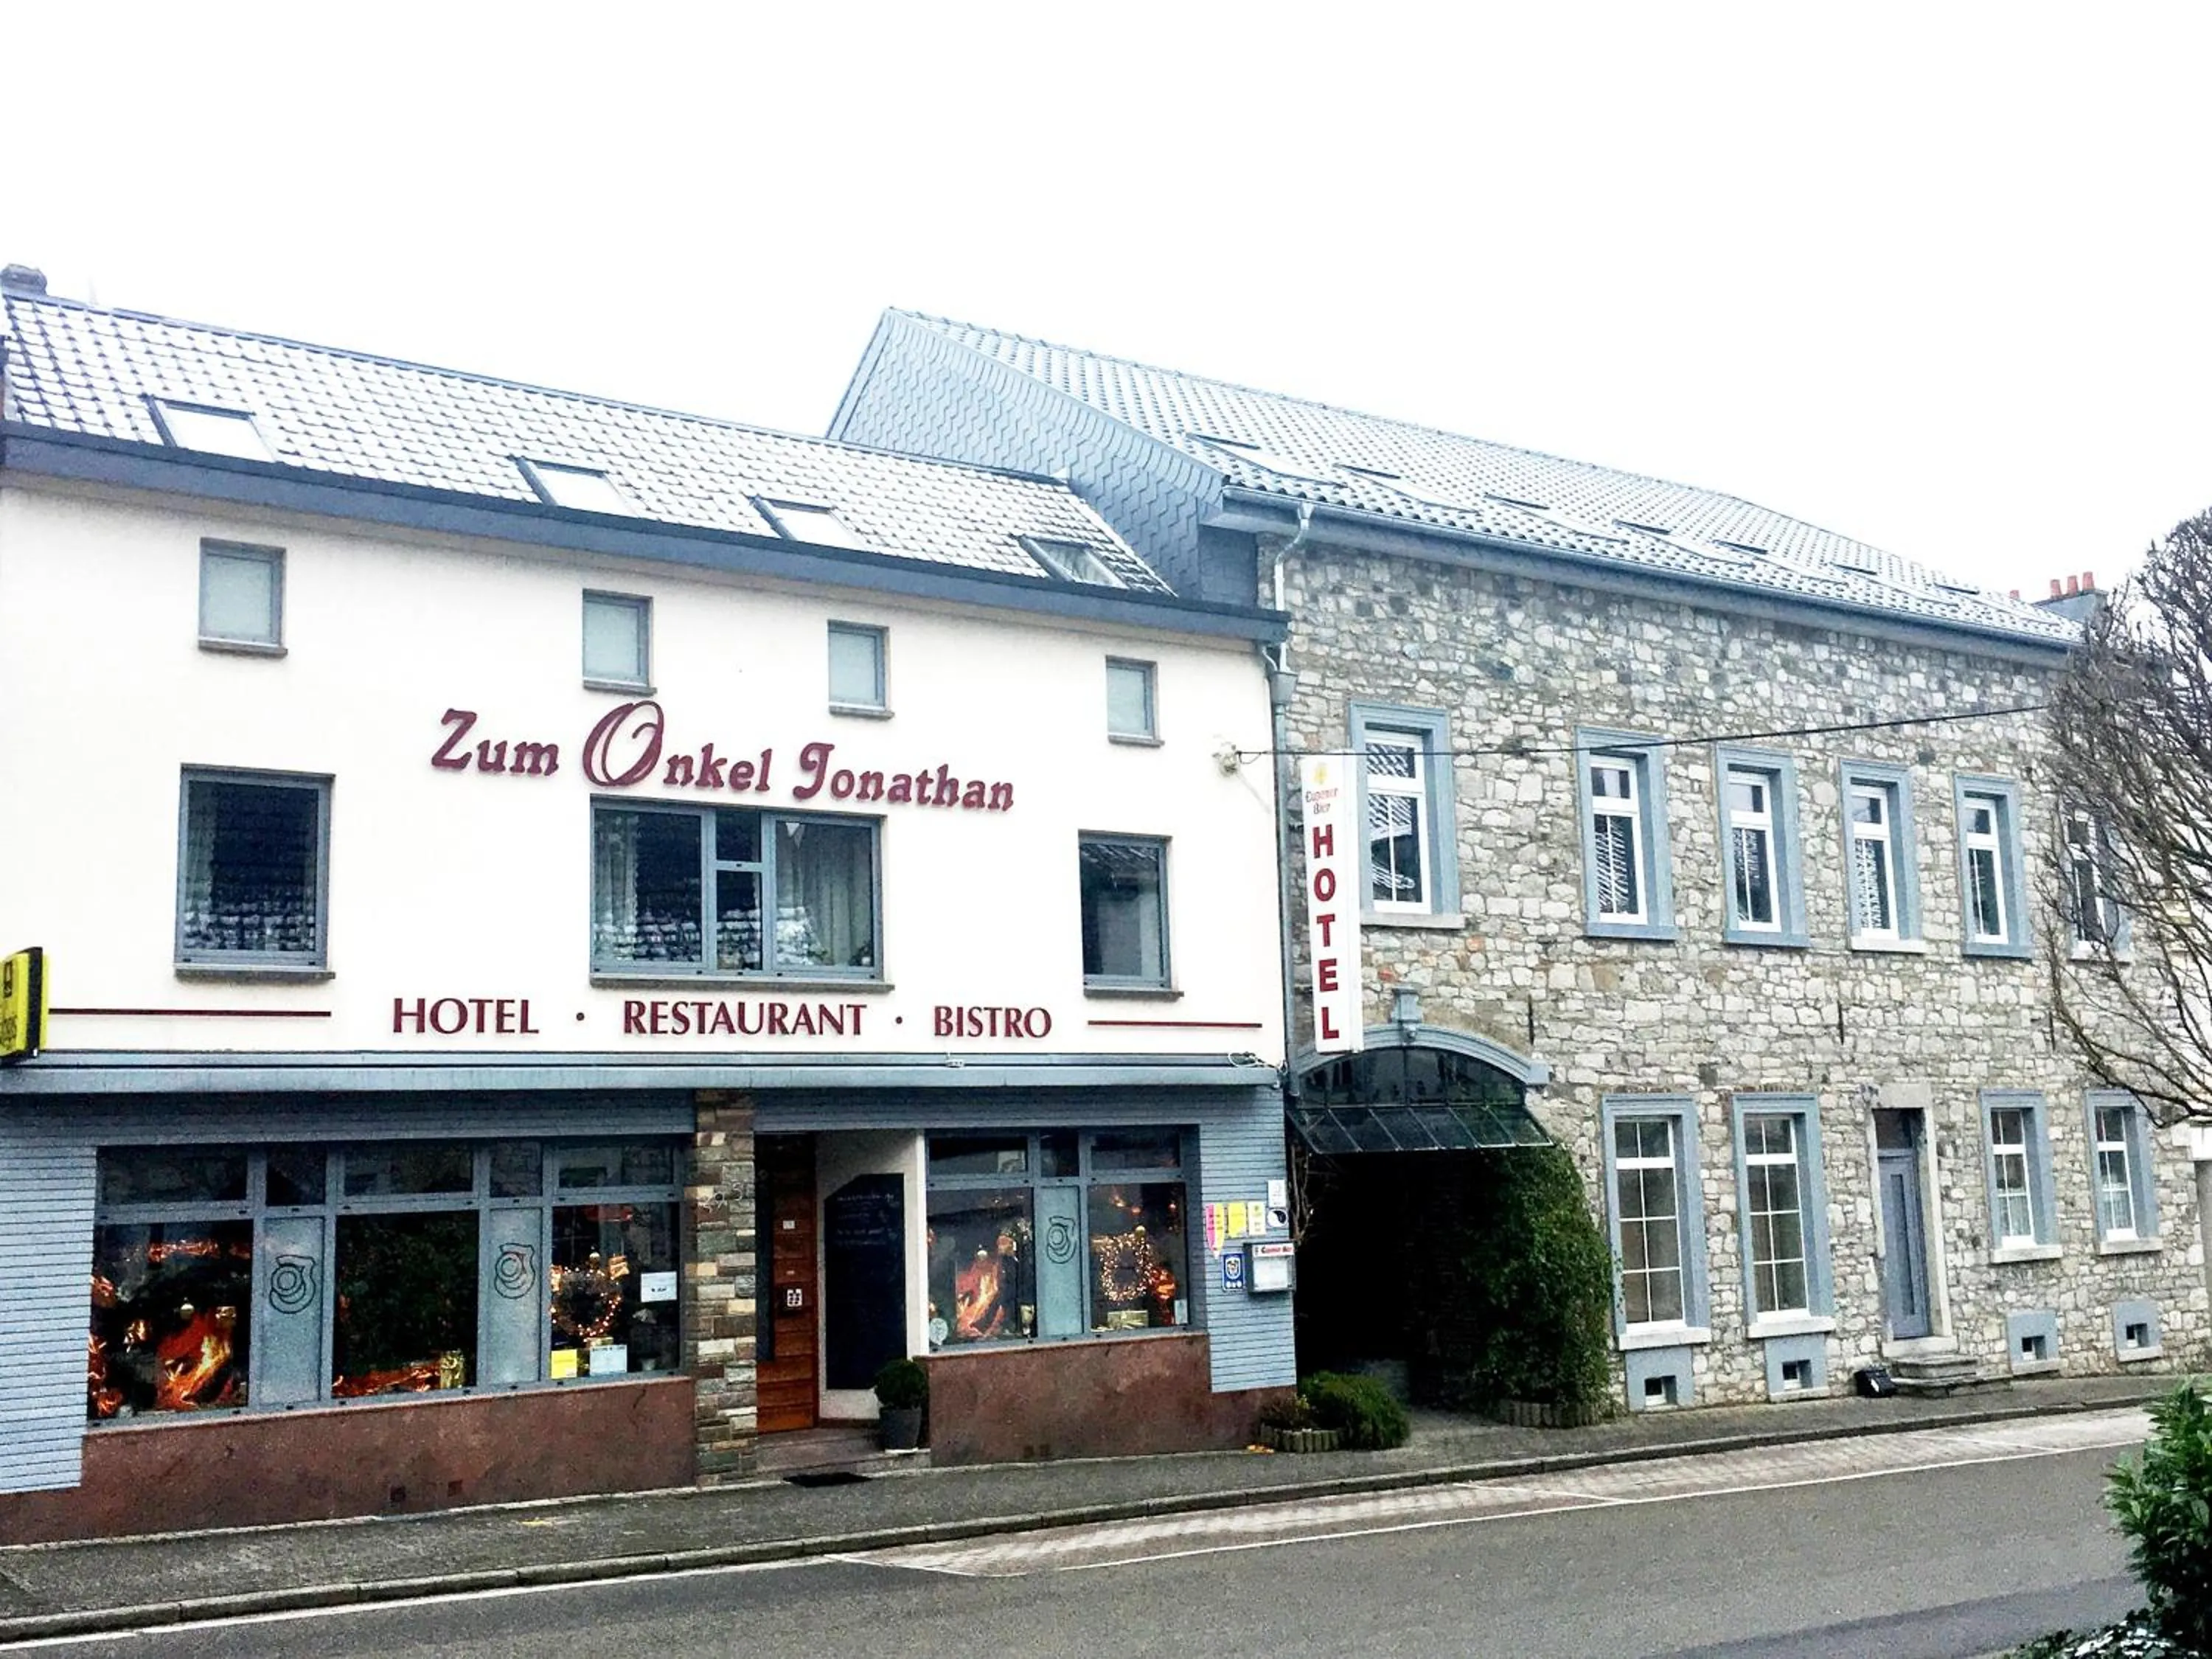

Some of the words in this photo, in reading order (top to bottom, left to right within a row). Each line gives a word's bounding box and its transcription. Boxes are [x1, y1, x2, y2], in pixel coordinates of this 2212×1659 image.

[431, 709, 560, 776] Zum
[582, 700, 773, 792] Onkel
[793, 742, 1014, 812] Jonathan
[1312, 824, 1340, 1040] HOTEL
[393, 998, 540, 1034] HOTEL
[623, 1000, 867, 1036] RESTAURANT
[933, 1006, 1052, 1038] BISTRO
